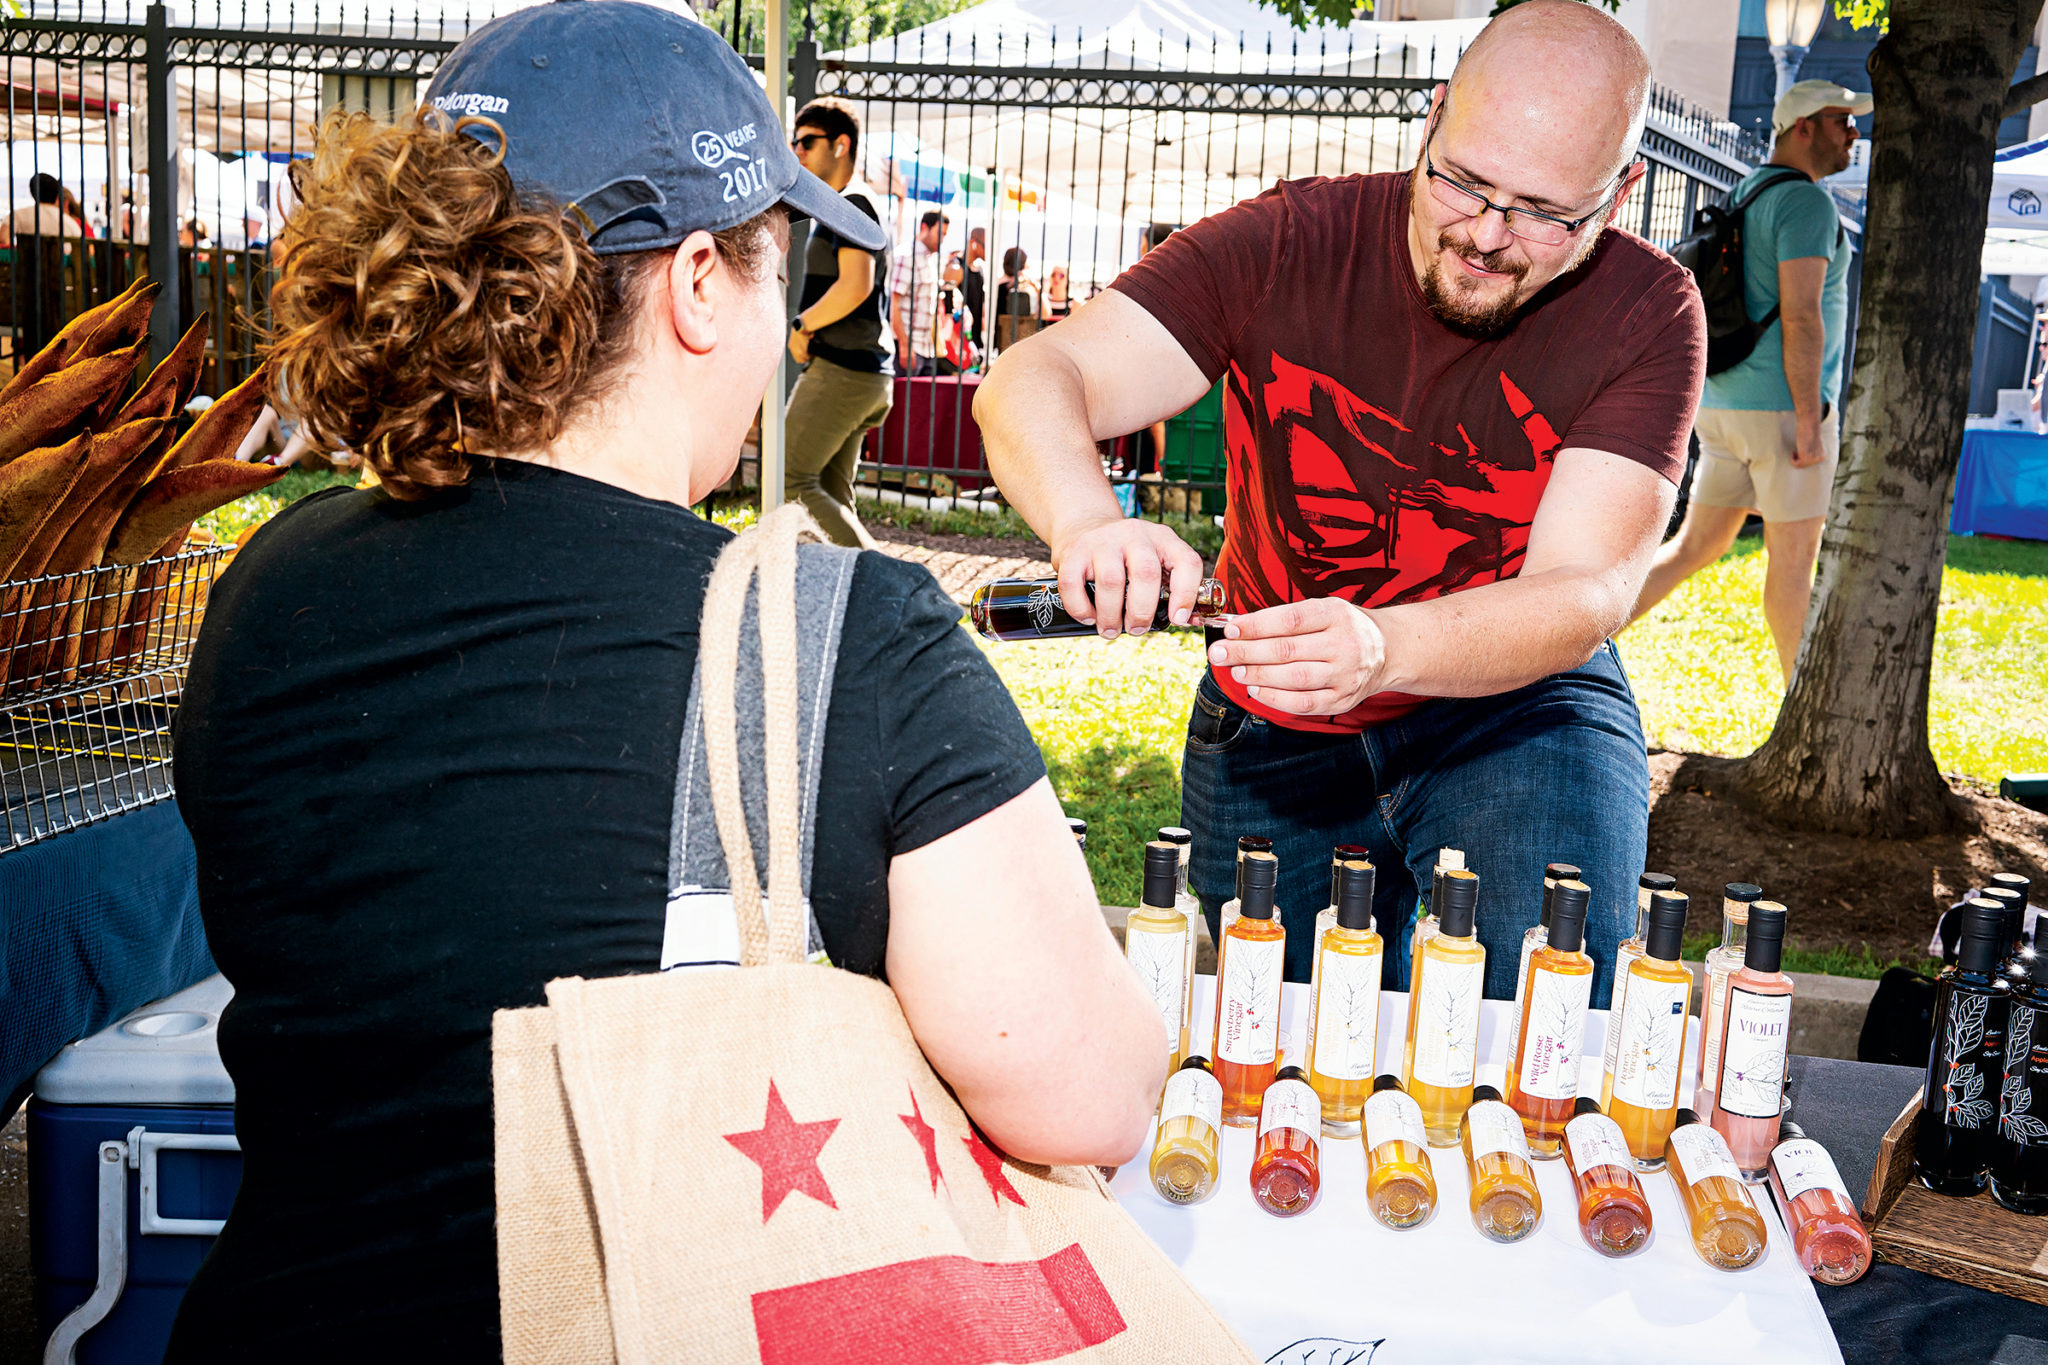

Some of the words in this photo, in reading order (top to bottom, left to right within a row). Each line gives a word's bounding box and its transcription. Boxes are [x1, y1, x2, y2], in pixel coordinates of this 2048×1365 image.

[698, 137, 722, 162] 25
[724, 122, 757, 148] YEARS
[718, 157, 768, 203] 2017
[1225, 996, 1237, 1054] Strawberry
[1233, 1001, 1244, 1041] Vinegar
[1740, 1018, 1782, 1036] VIOLET
[1533, 1034, 1545, 1063] Rose
[1540, 1035, 1554, 1075] Vinegar
[1627, 1040, 1640, 1080] Vinegar
